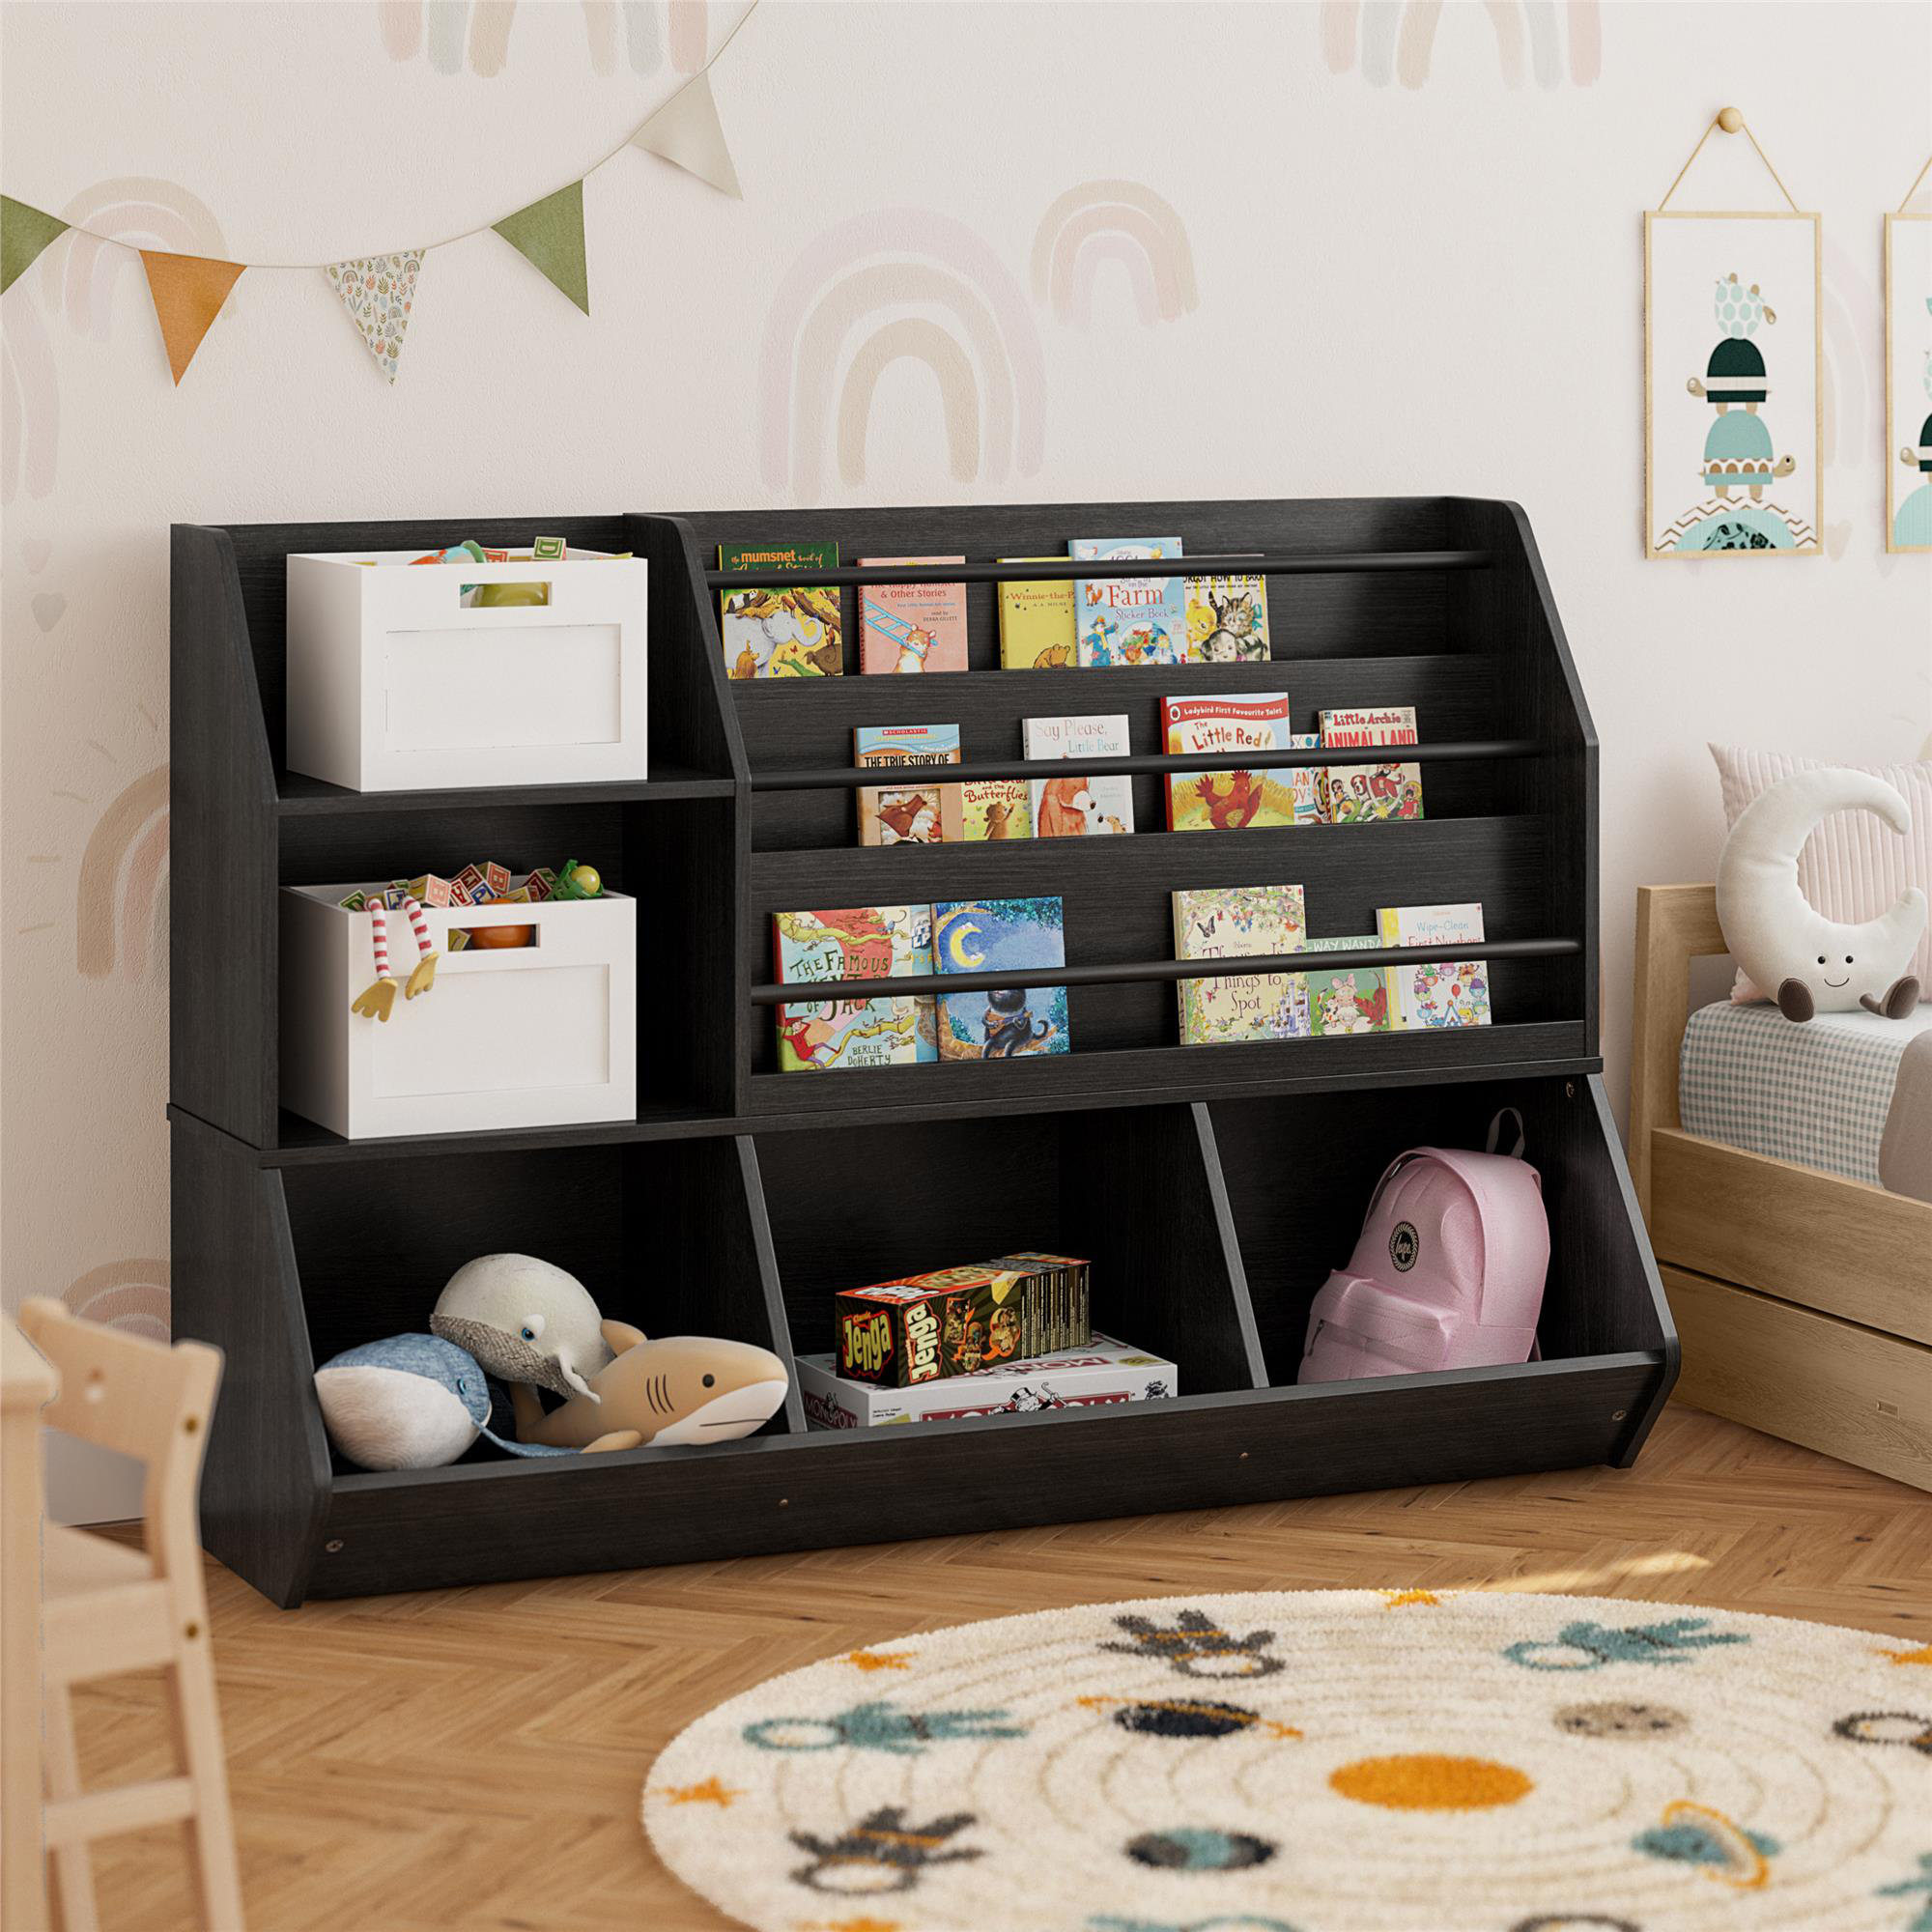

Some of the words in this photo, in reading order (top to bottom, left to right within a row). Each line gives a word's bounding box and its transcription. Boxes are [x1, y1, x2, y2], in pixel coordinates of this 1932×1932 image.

[741, 549, 797, 563] mumsnet
[891, 589, 915, 599] Other
[918, 588, 947, 598] Stories
[1106, 584, 1164, 608] Farm
[1116, 610, 1145, 620] Sticker
[1148, 608, 1169, 618] Book
[1184, 707, 1214, 717] Ladybird
[1265, 707, 1284, 716] Tales
[1333, 713, 1365, 726] Little
[1367, 712, 1402, 724] Archie
[1036, 722, 1060, 741] Say
[1064, 718, 1108, 736] Please,
[1195, 721, 1208, 730] The
[1067, 739, 1094, 753] Little
[1096, 738, 1120, 752] Bear
[1192, 726, 1232, 751] Little
[1236, 727, 1262, 748] Red
[1326, 729, 1373, 749] ANIMAL
[865, 756, 881, 768] THE
[908, 754, 935, 766] STORY
[964, 785, 1028, 803] Butterflies
[1416, 920, 1469, 936] Wipe-Clean
[789, 958, 820, 978] THE
[824, 950, 890, 972] FAMOUS
[1231, 990, 1262, 1019] Spot
[852, 1044, 883, 1055] BERLIE
[847, 1054, 891, 1067] DOHERTY
[844, 1314, 891, 1372] Jenga
[906, 1303, 939, 1380] Jenga
